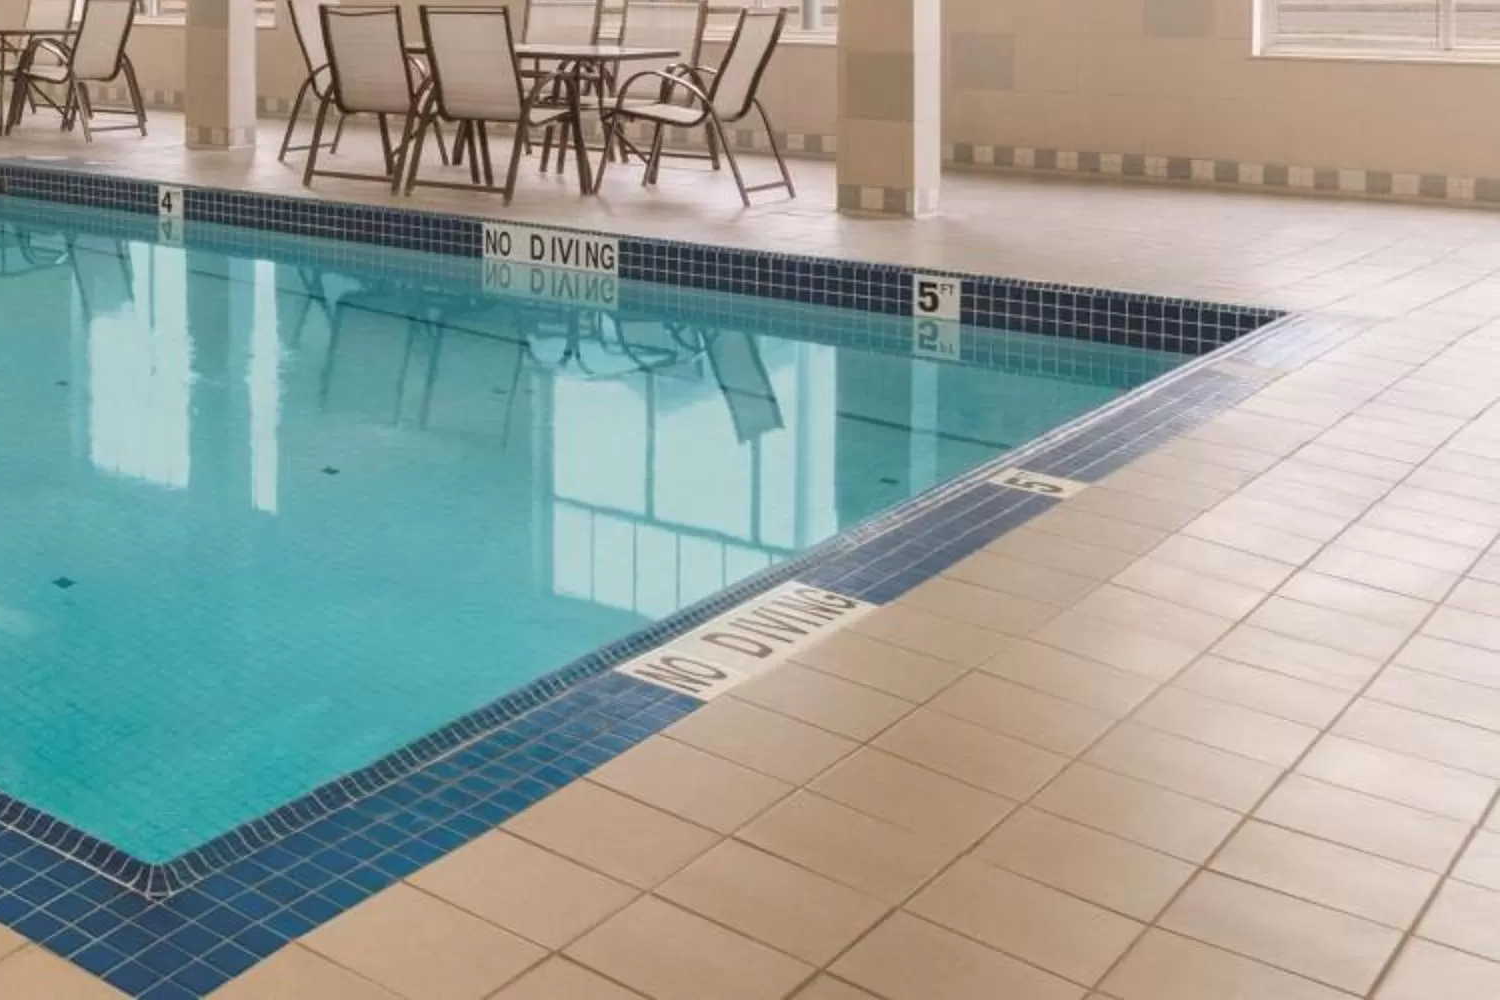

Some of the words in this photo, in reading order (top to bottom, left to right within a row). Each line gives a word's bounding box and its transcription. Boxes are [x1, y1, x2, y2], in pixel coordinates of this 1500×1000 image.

[484, 229, 512, 256] NO
[530, 233, 616, 271] DIVING
[633, 656, 728, 694] NO
[701, 588, 857, 660] DIVING
